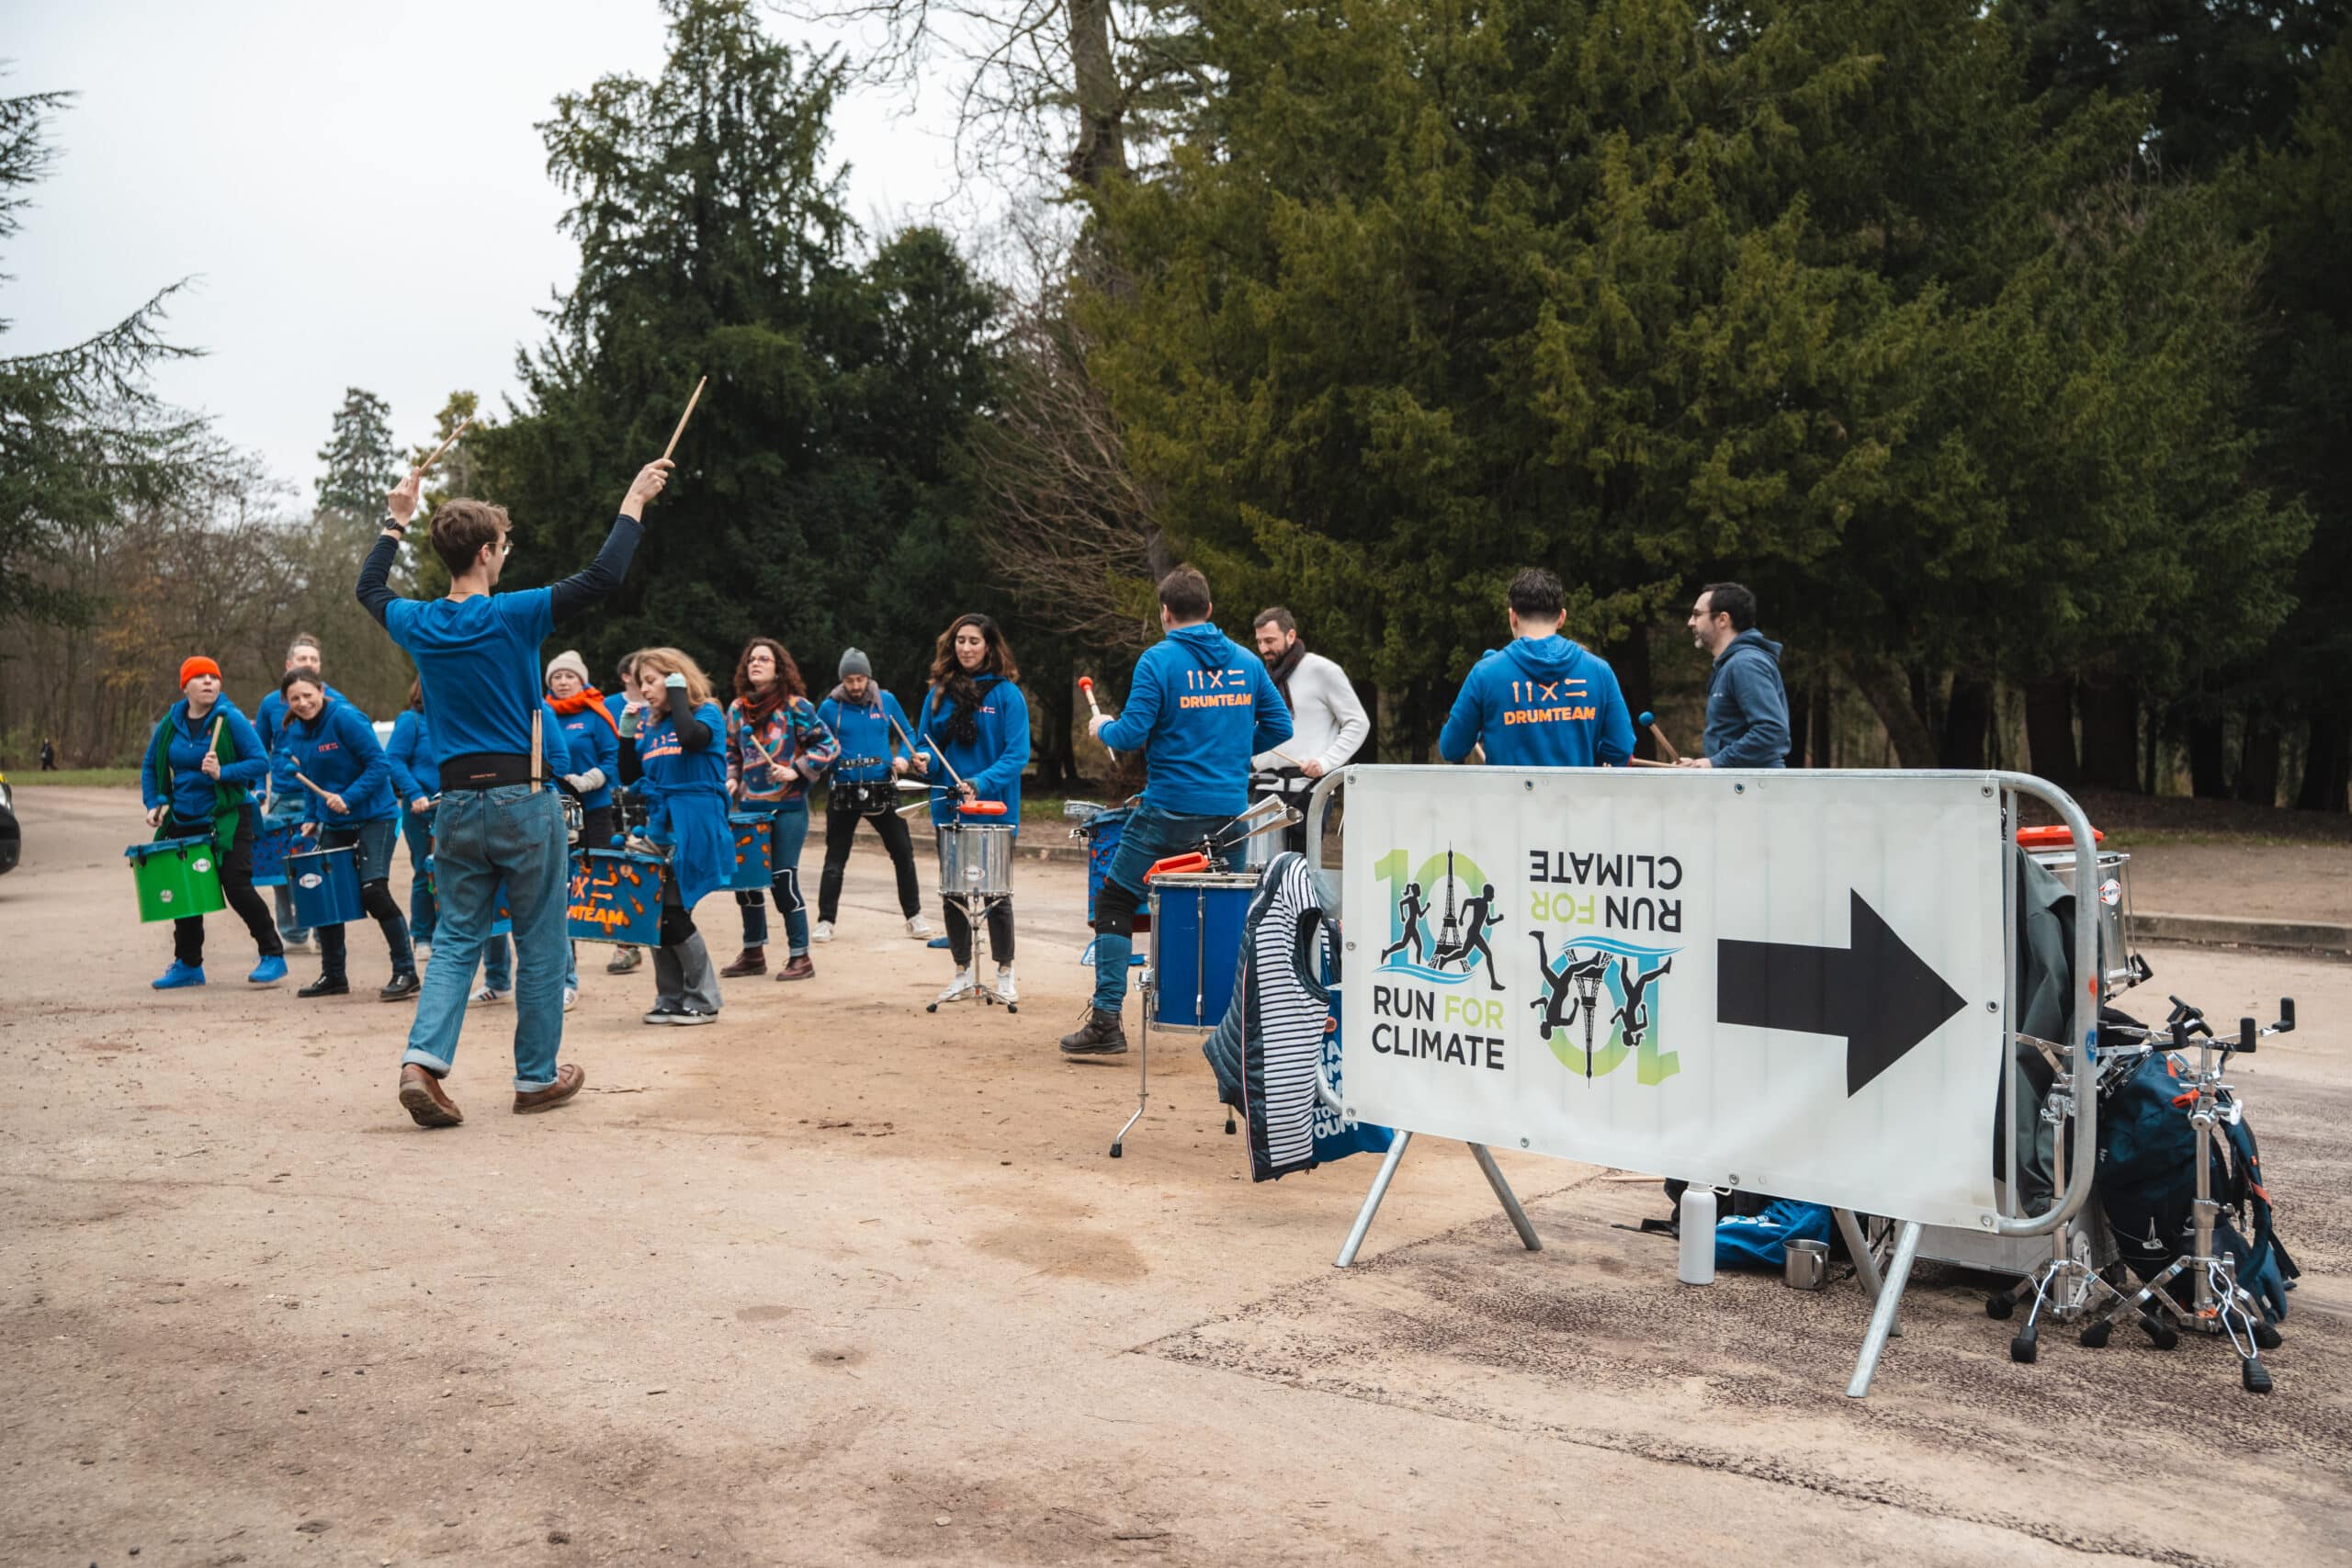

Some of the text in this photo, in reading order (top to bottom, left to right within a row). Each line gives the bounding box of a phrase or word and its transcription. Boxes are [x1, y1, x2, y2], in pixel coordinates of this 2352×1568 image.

[1180, 694, 1251, 709] DRUMTEAM
[1504, 706, 1596, 726] DRUMTEAM
[1530, 850, 1683, 890] CLIMATE
[1530, 890, 1682, 933] RUN FOR
[1374, 985, 1504, 1030] RUN FOR
[1372, 1022, 1505, 1071] CLIMATE
